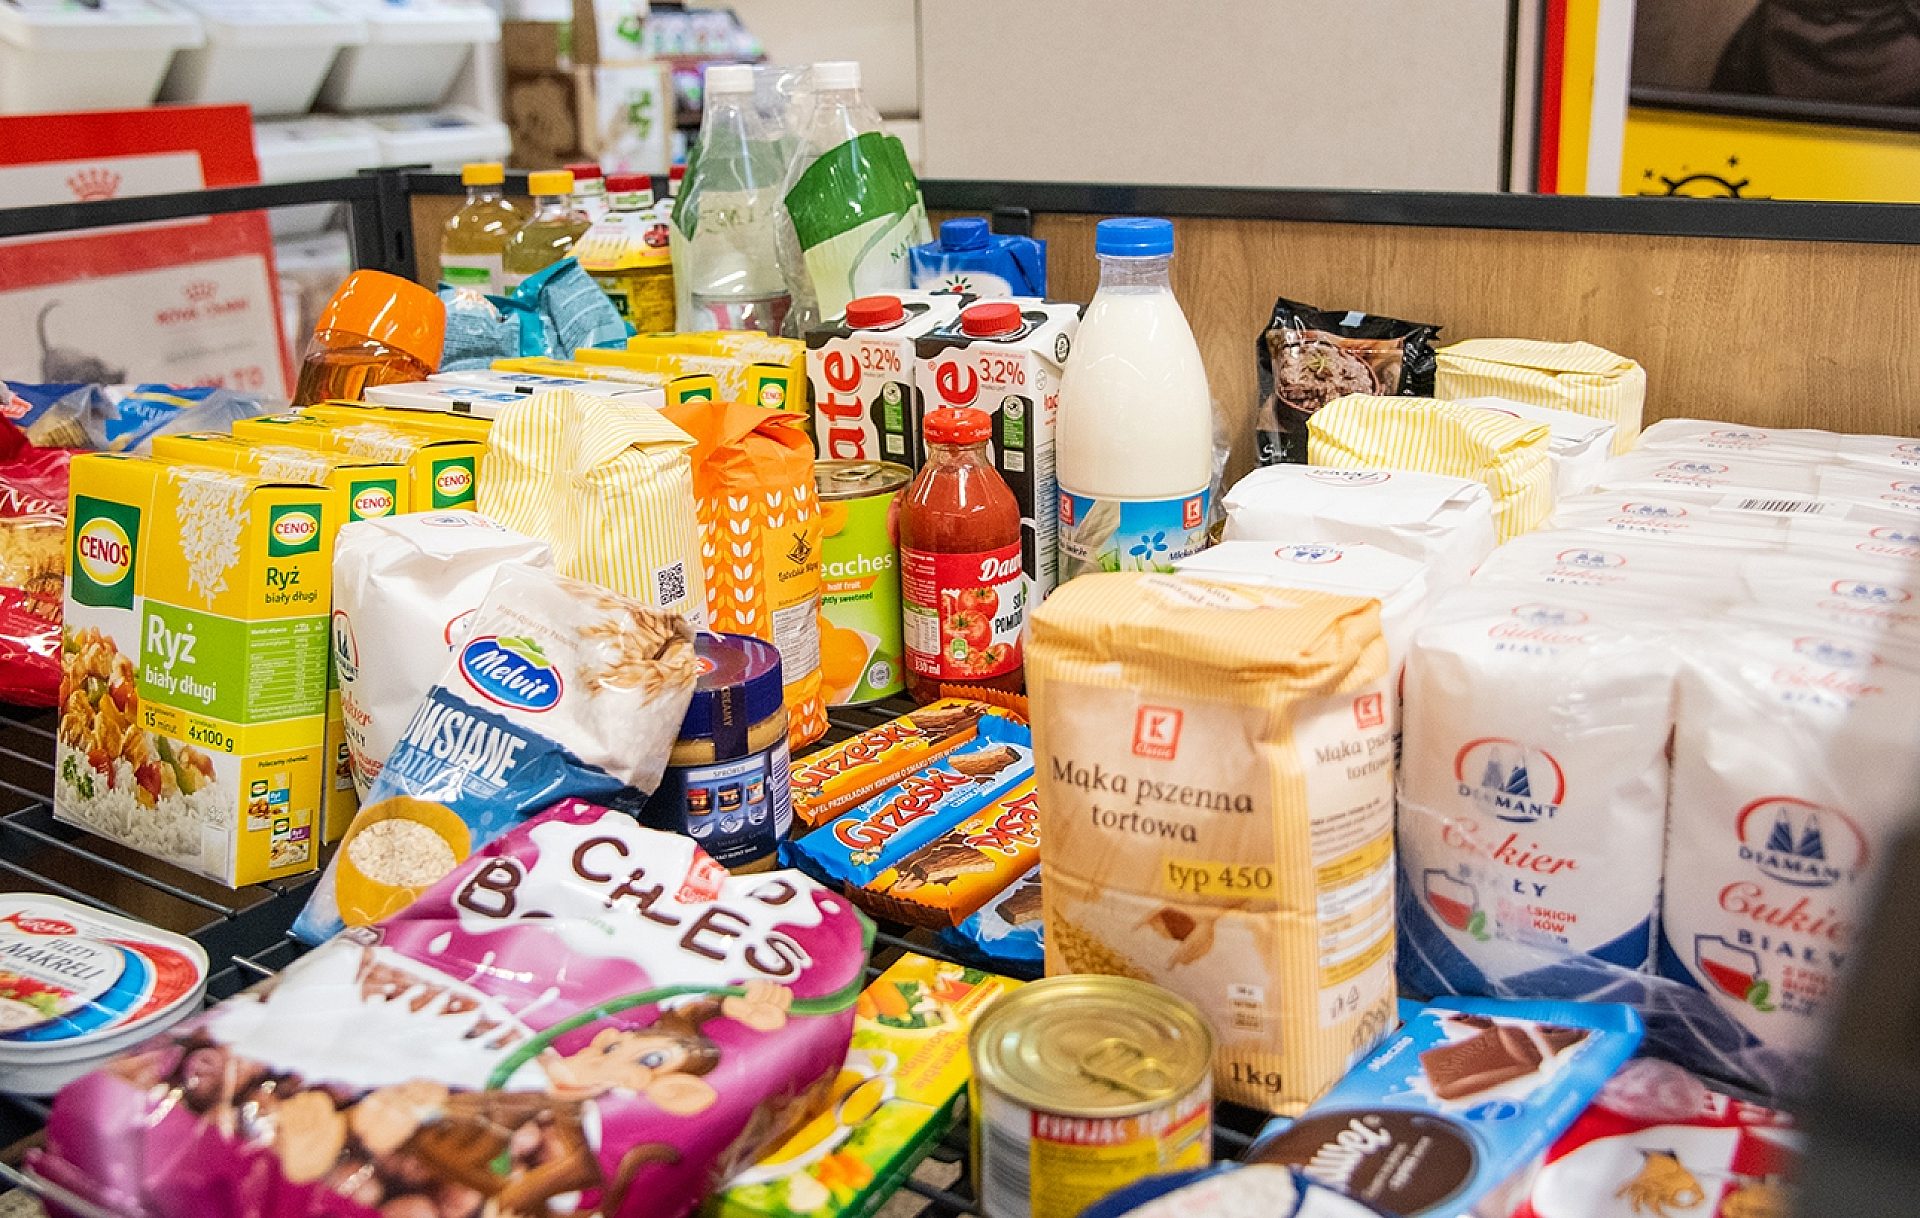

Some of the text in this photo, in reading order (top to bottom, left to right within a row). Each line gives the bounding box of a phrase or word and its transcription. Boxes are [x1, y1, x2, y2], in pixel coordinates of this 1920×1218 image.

[437, 473, 471, 488] CENOS
[355, 496, 392, 510] CENOS
[274, 521, 316, 535] CENOS
[79, 535, 130, 567] CENOS
[266, 565, 301, 591] Ryż
[265, 589, 318, 605] biały długi
[147, 614, 197, 671] Ryż
[145, 663, 217, 705] biały długi
[468, 649, 550, 700] Melvit
[144, 711, 156, 727] 15
[189, 725, 234, 753] 4x100 g
[1052, 755, 1254, 814] Mąka pszenna
[1091, 803, 1198, 843] tortowa
[1168, 862, 1273, 892] typ 450
[1231, 1061, 1282, 1093] 1kg
